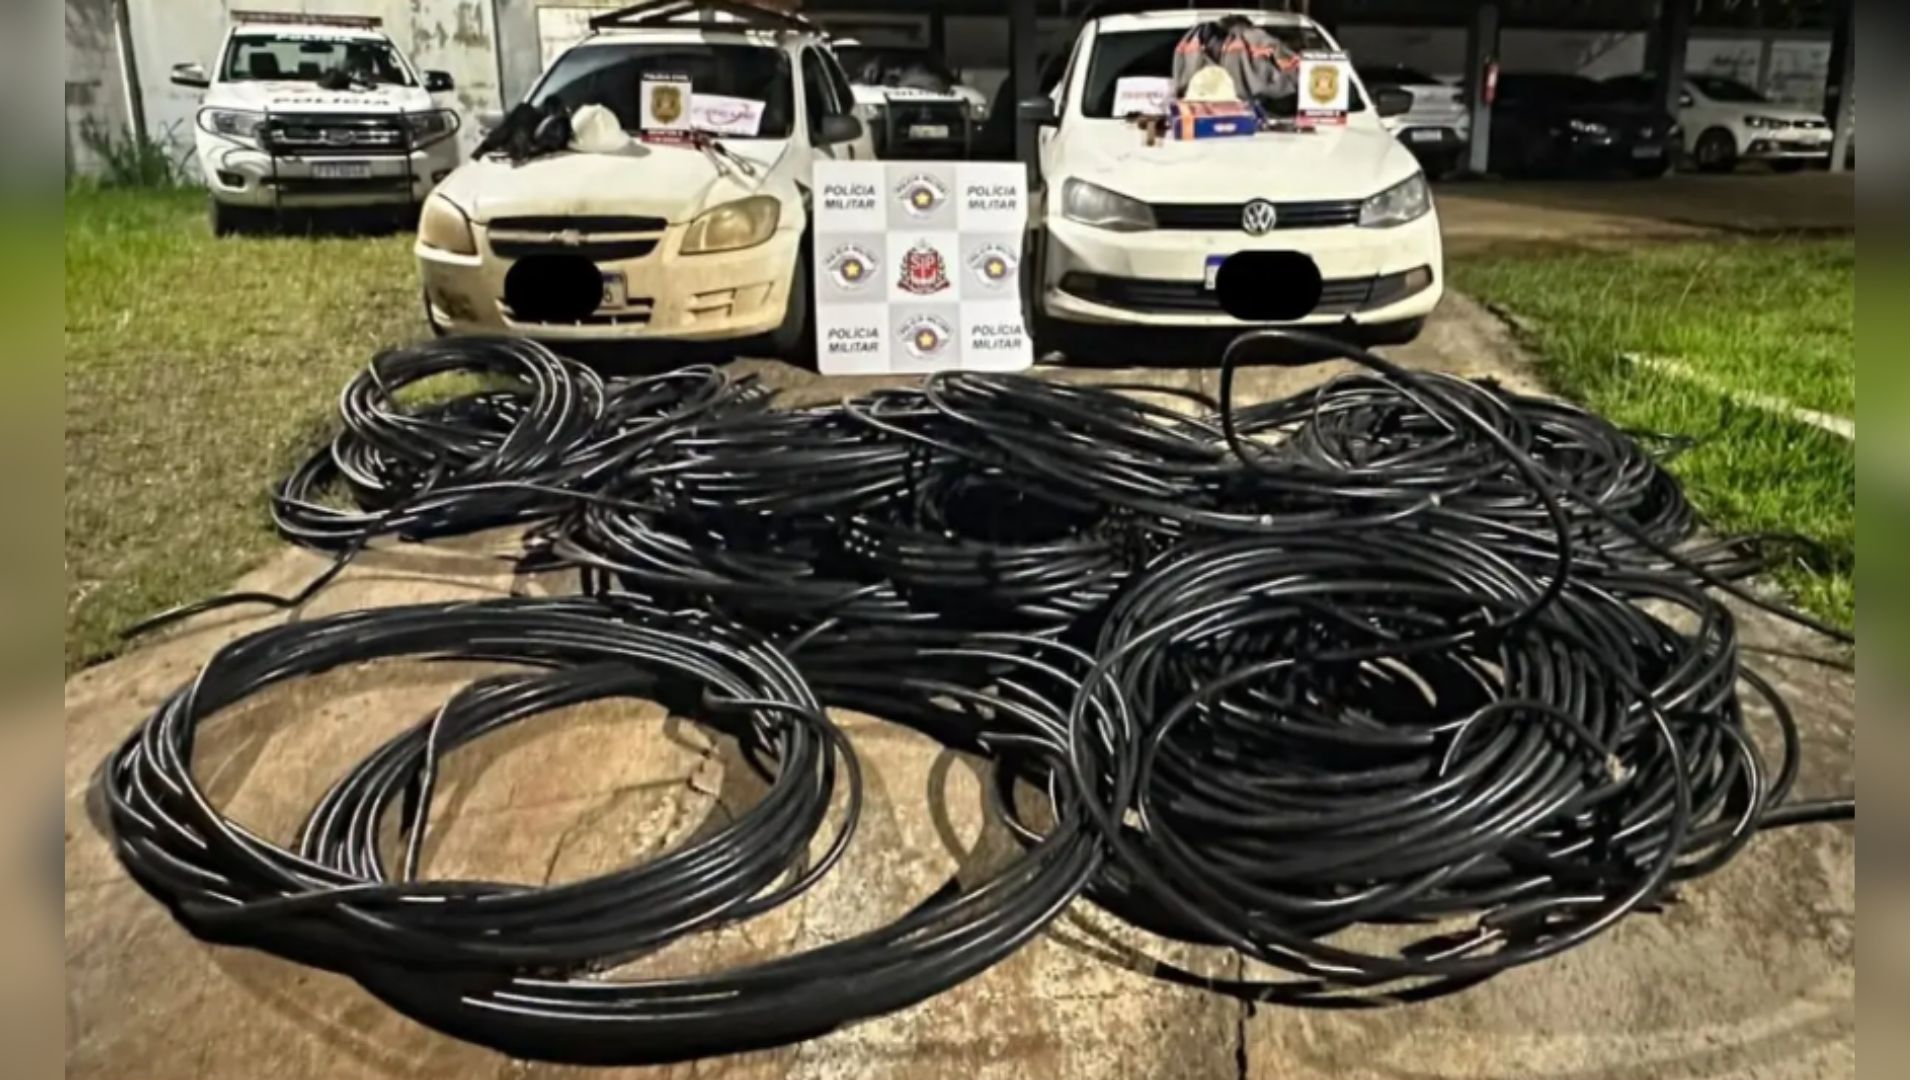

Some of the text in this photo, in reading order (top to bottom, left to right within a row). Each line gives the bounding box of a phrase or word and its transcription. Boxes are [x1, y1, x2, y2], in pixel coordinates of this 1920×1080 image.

[824, 184, 875, 197] POLÍCIA
[967, 185, 1016, 197] POLÍCIA
[824, 199, 875, 210] MILITAR
[968, 200, 1016, 210] MILITAR
[828, 327, 879, 339] POLÍCIA
[972, 324, 1022, 336] POLÍCIA
[828, 341, 879, 353] MILITAR
[972, 339, 1022, 350] MILITAR
